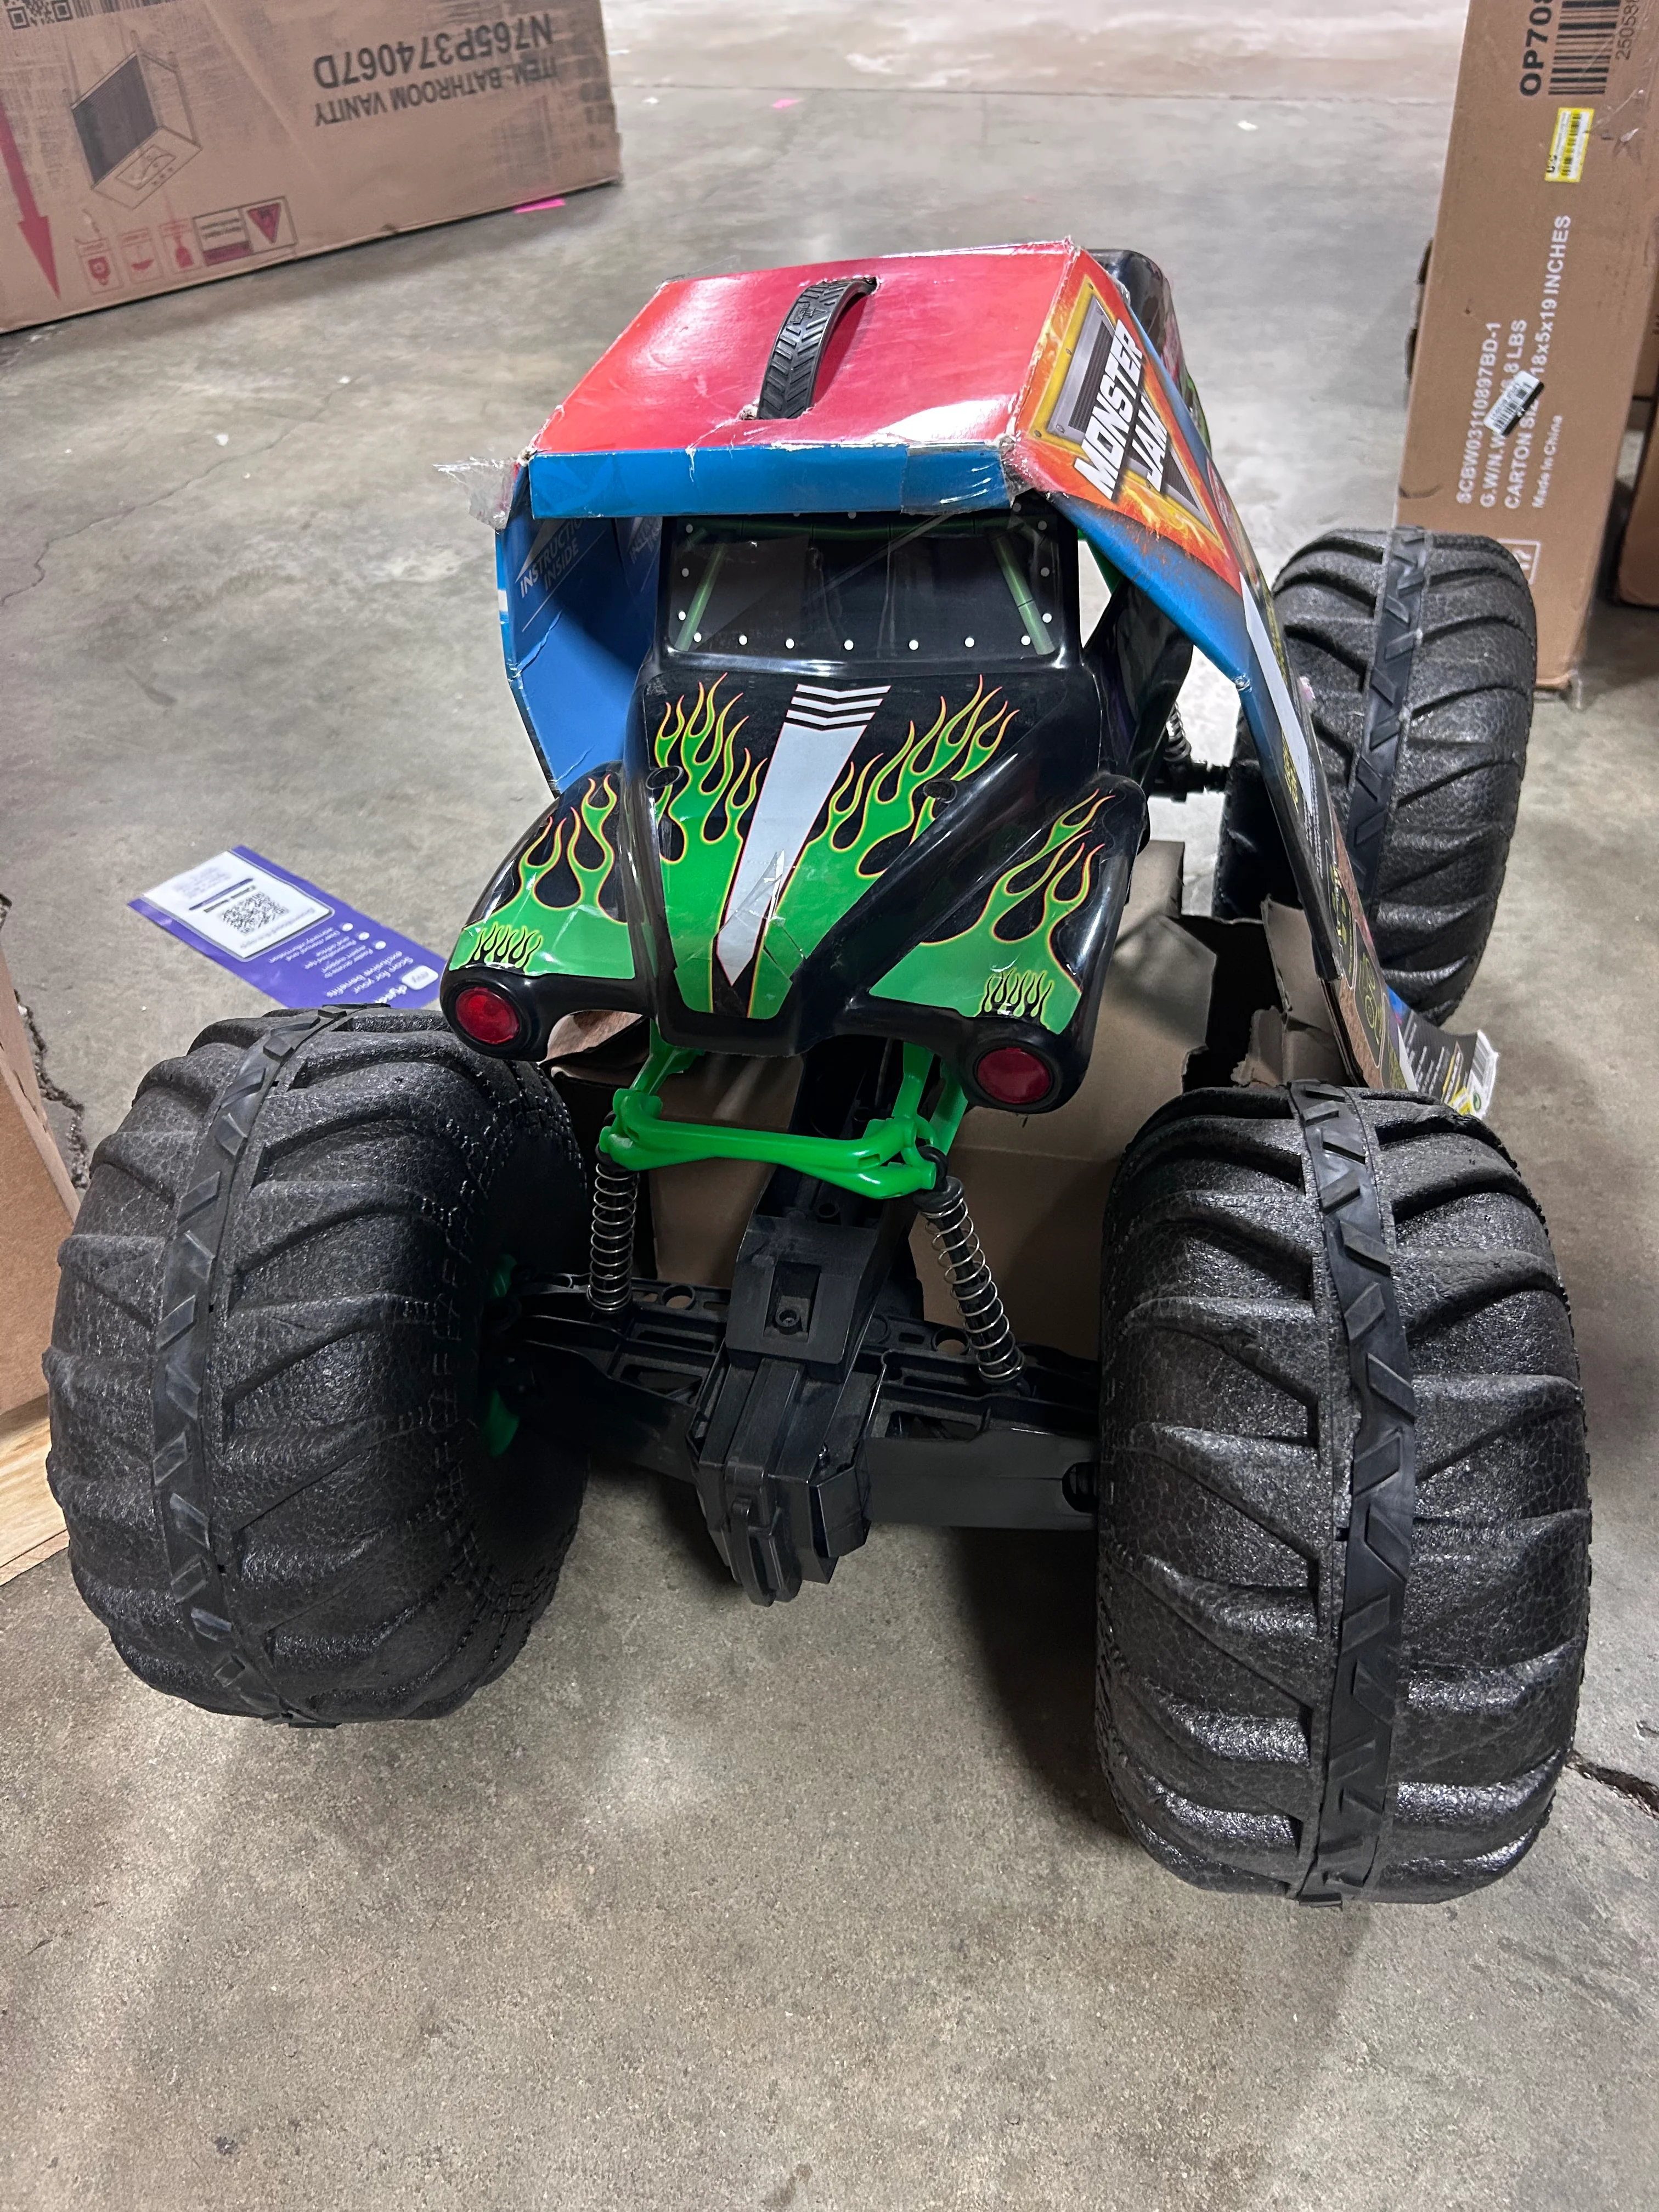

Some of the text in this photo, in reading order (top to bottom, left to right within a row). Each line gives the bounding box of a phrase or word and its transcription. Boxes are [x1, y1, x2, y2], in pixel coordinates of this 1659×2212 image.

[314, 13, 553, 89] N765P374067D
[1520, 0, 1553, 96] OP70
[1615, 0, 1640, 60] 25058
[315, 91, 388, 126] VANITY
[1504, 432, 1533, 509] CARTON
[1543, 215, 1571, 295] INCHES
[1506, 319, 1527, 359] LBS
[1074, 319, 1167, 500] MONSTER JAM
[1532, 472, 1551, 509] Made
[1543, 415, 1562, 456] China
[543, 537, 579, 591] INSIDE
